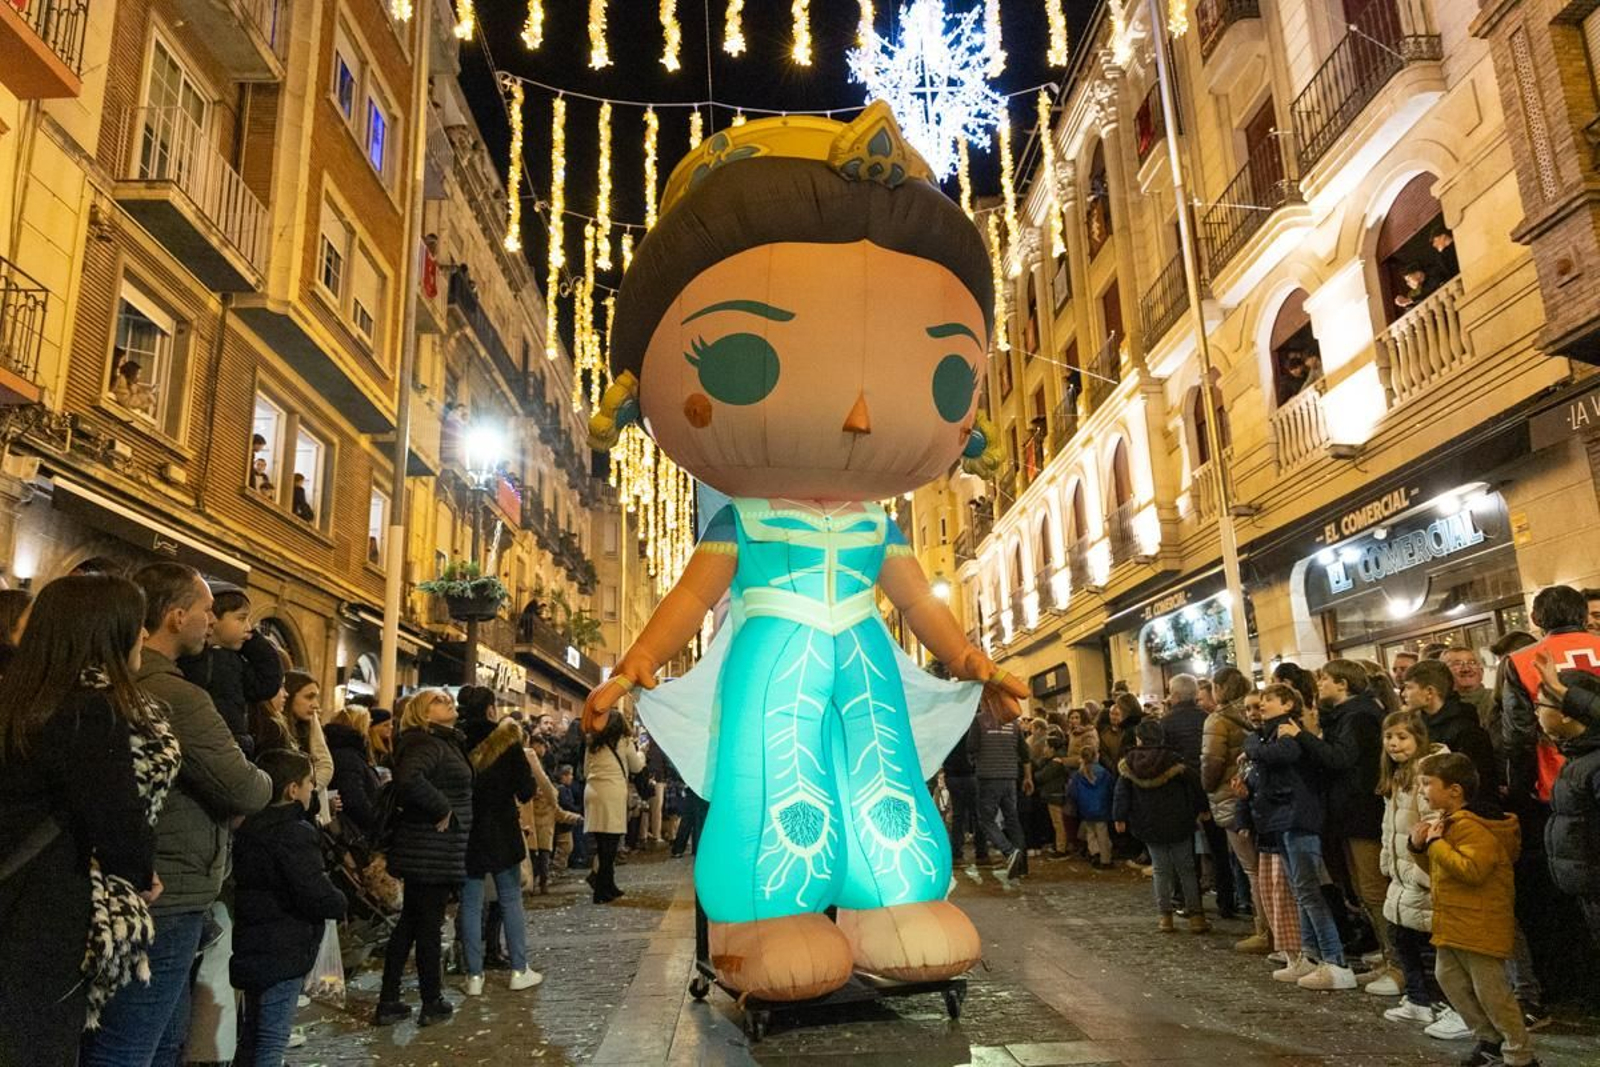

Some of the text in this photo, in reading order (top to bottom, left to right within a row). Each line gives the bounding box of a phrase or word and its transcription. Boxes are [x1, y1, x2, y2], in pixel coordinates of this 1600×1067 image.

[1324, 487, 1410, 544] EL COMERCIAL
[1357, 509, 1485, 583] COMERCIAL
